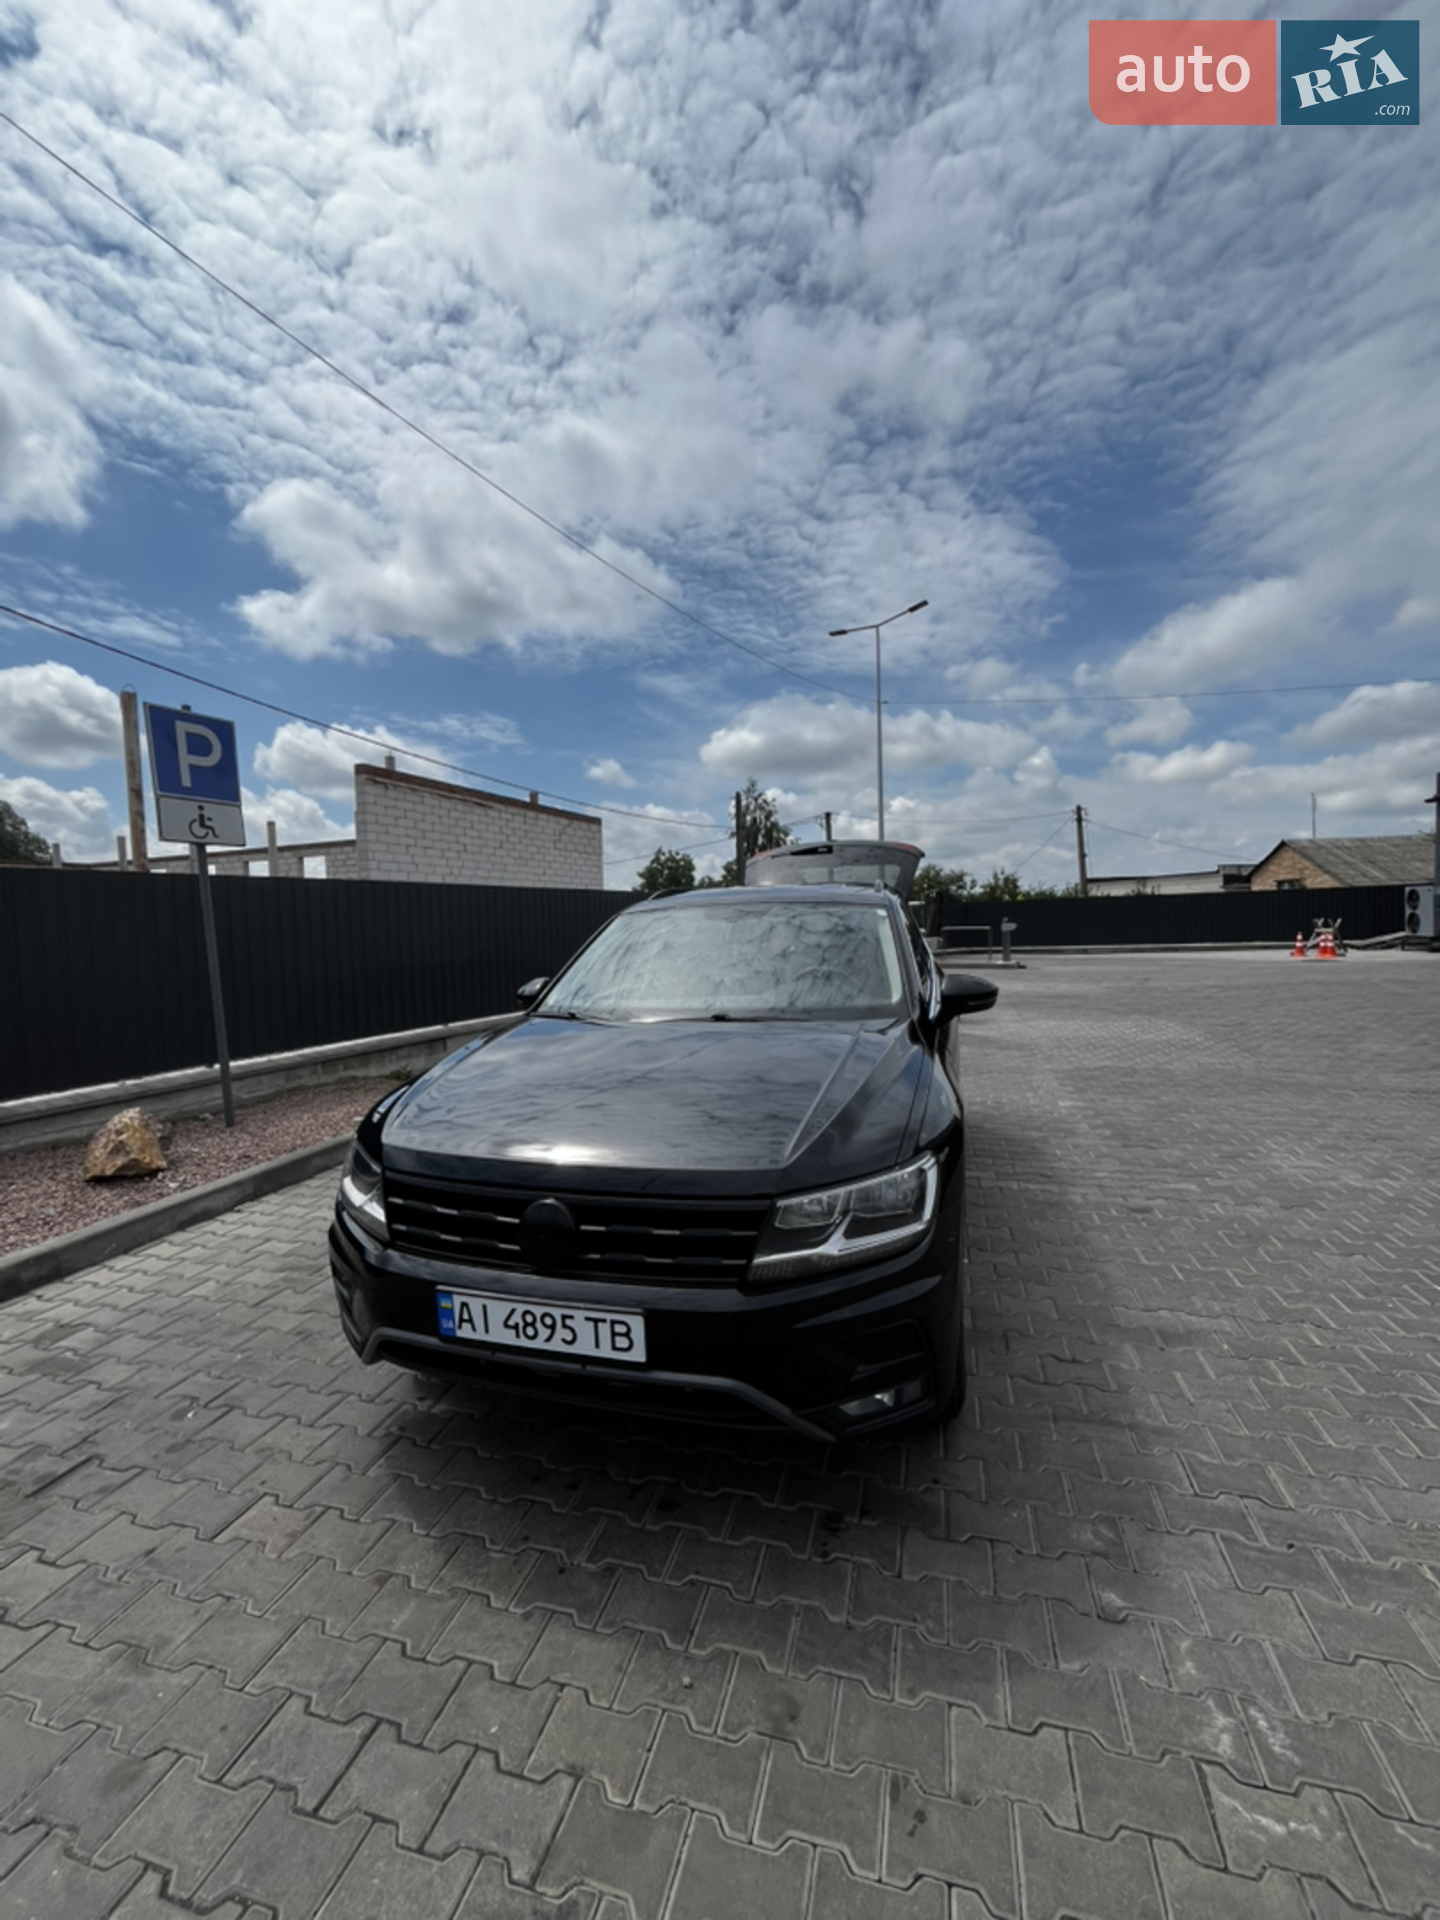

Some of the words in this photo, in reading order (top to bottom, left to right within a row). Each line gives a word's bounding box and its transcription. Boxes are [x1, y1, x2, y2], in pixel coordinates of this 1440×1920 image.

[174, 720, 222, 788] P
[457, 1301, 490, 1334] AI
[502, 1308, 578, 1346] 4895
[584, 1316, 634, 1353] TB
